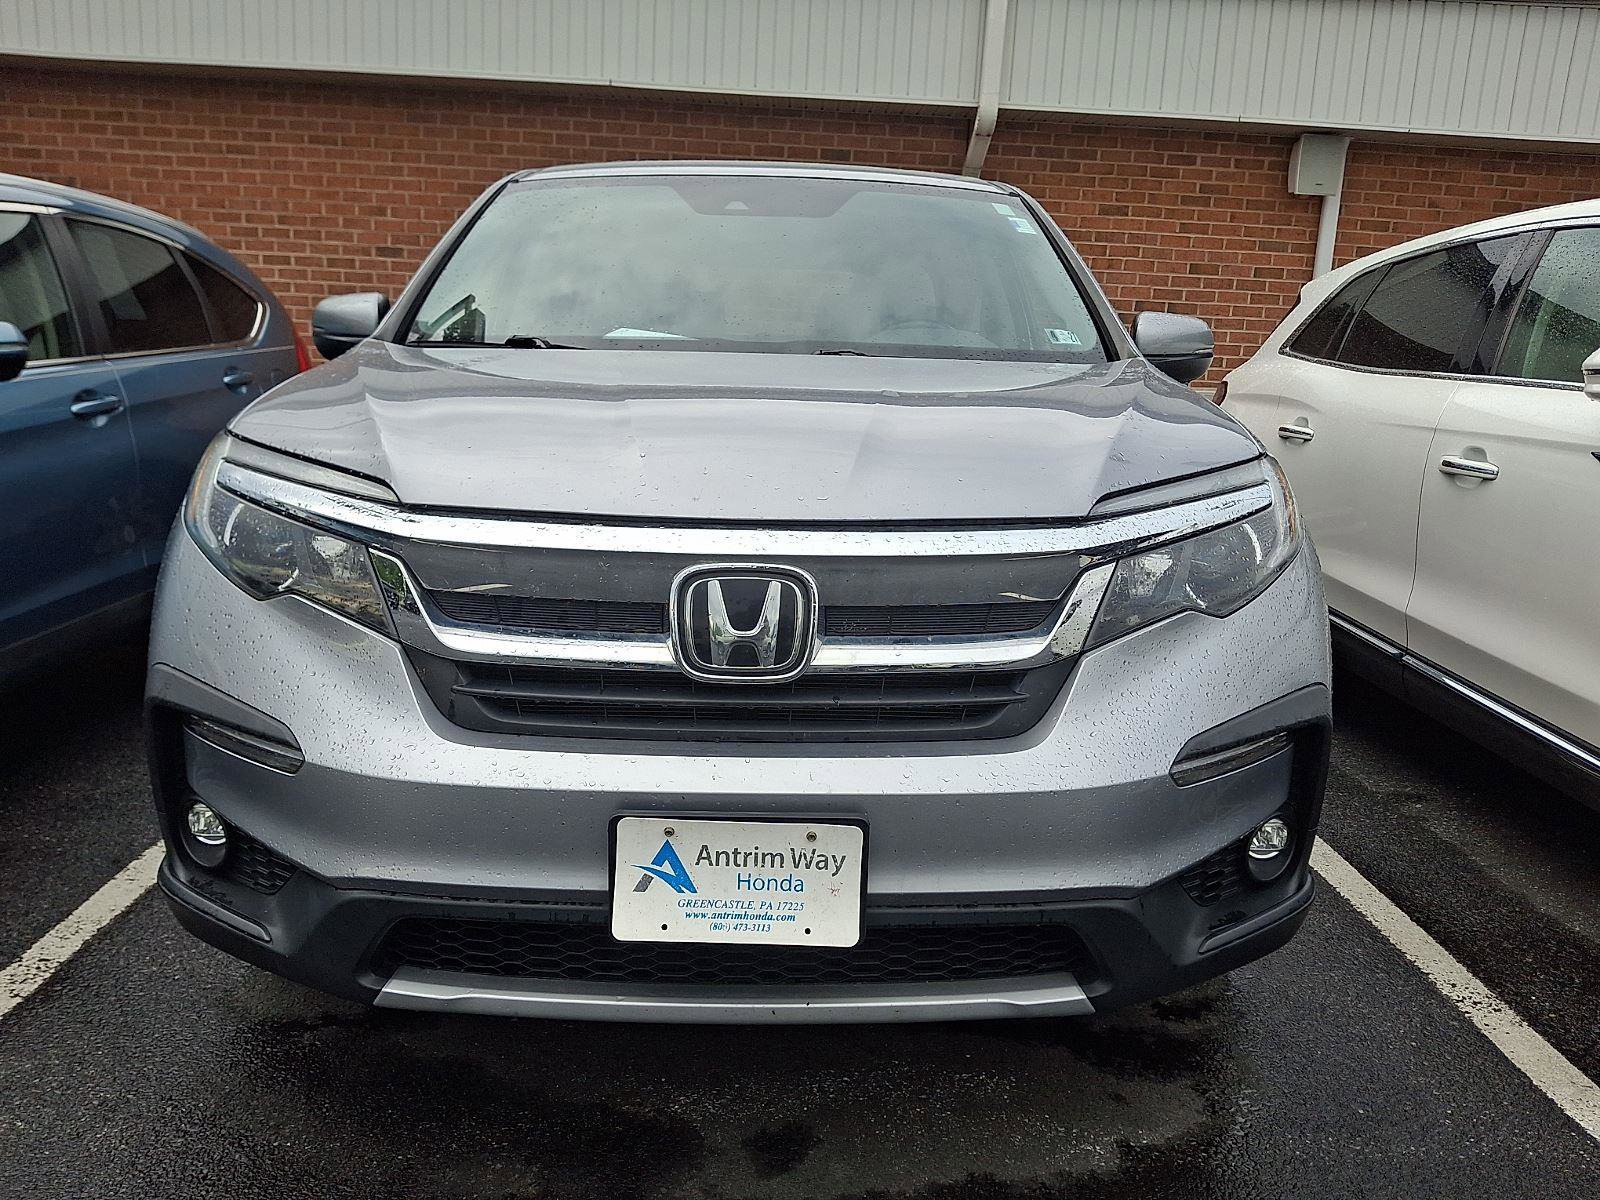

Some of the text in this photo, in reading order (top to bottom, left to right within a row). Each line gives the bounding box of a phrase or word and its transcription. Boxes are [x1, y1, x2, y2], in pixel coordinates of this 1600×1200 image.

[695, 844, 846, 877] Antrim Way
[737, 873, 804, 892] Honda
[677, 898, 805, 911] GREENCASTLE, PA 17225
[685, 910, 796, 922] www.antrimhonda.com
[733, 923, 771, 932] 473-3113
